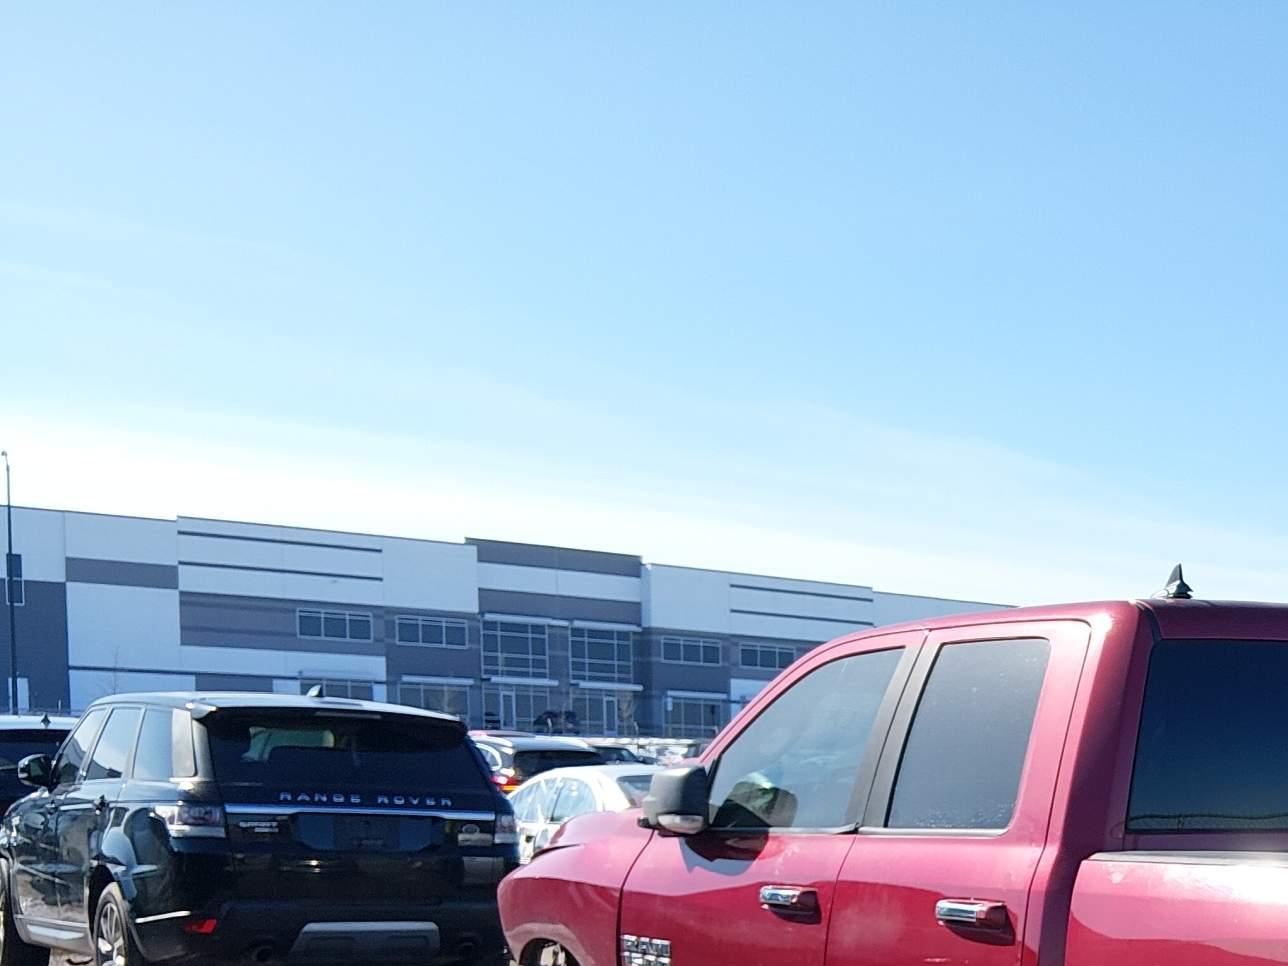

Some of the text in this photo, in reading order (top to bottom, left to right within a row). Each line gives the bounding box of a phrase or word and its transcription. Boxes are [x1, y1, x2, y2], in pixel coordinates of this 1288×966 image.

[279, 791, 452, 806] RANGE ROVER
[620, 934, 672, 956] RAM
